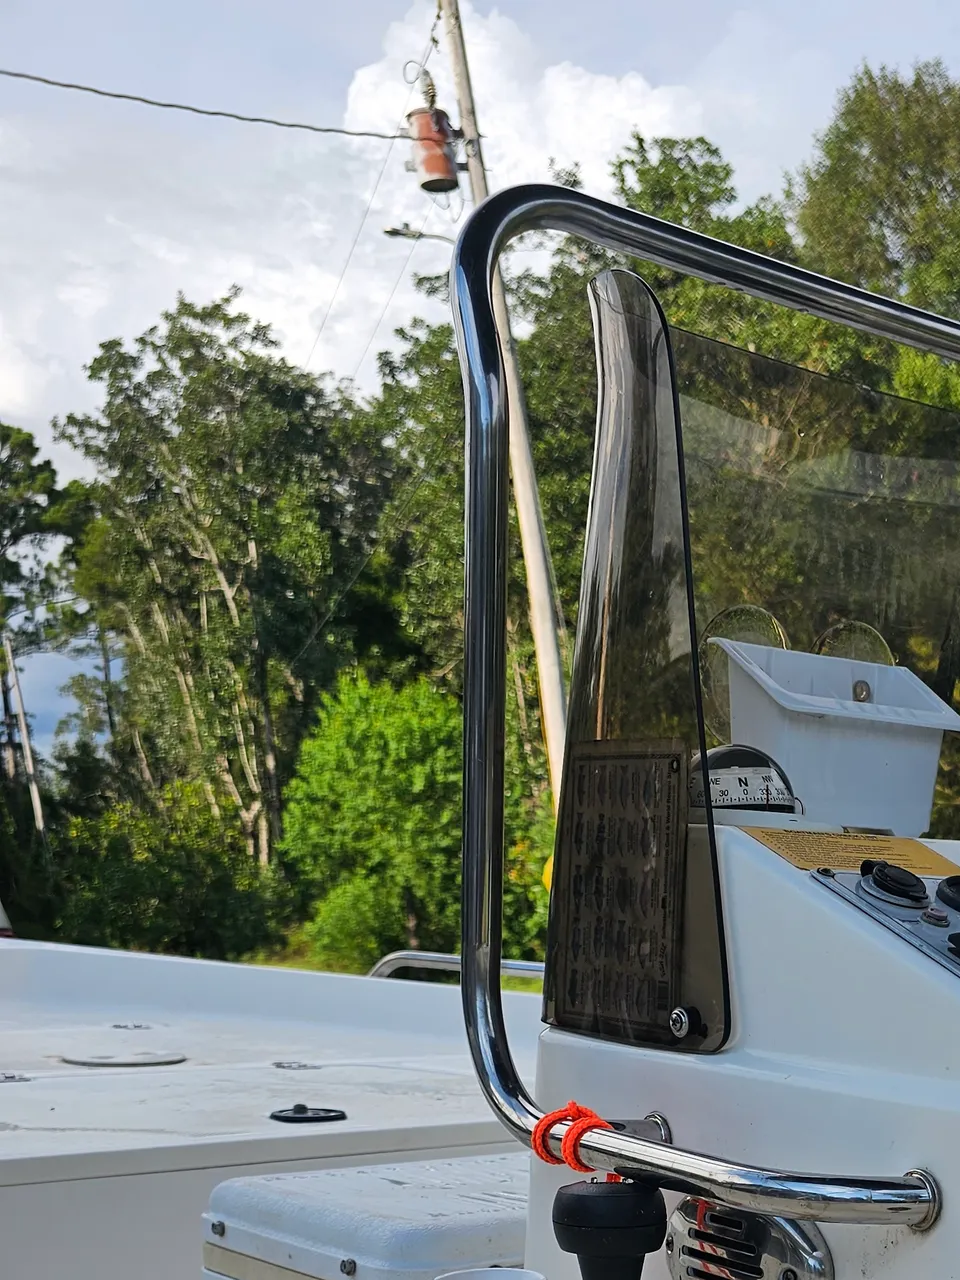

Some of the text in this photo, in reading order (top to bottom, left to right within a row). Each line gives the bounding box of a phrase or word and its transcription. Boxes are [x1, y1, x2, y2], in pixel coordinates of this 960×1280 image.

[710, 777, 721, 785] NE
[738, 777, 749, 787] N
[762, 775, 774, 783] NW
[719, 789, 728, 797] 30
